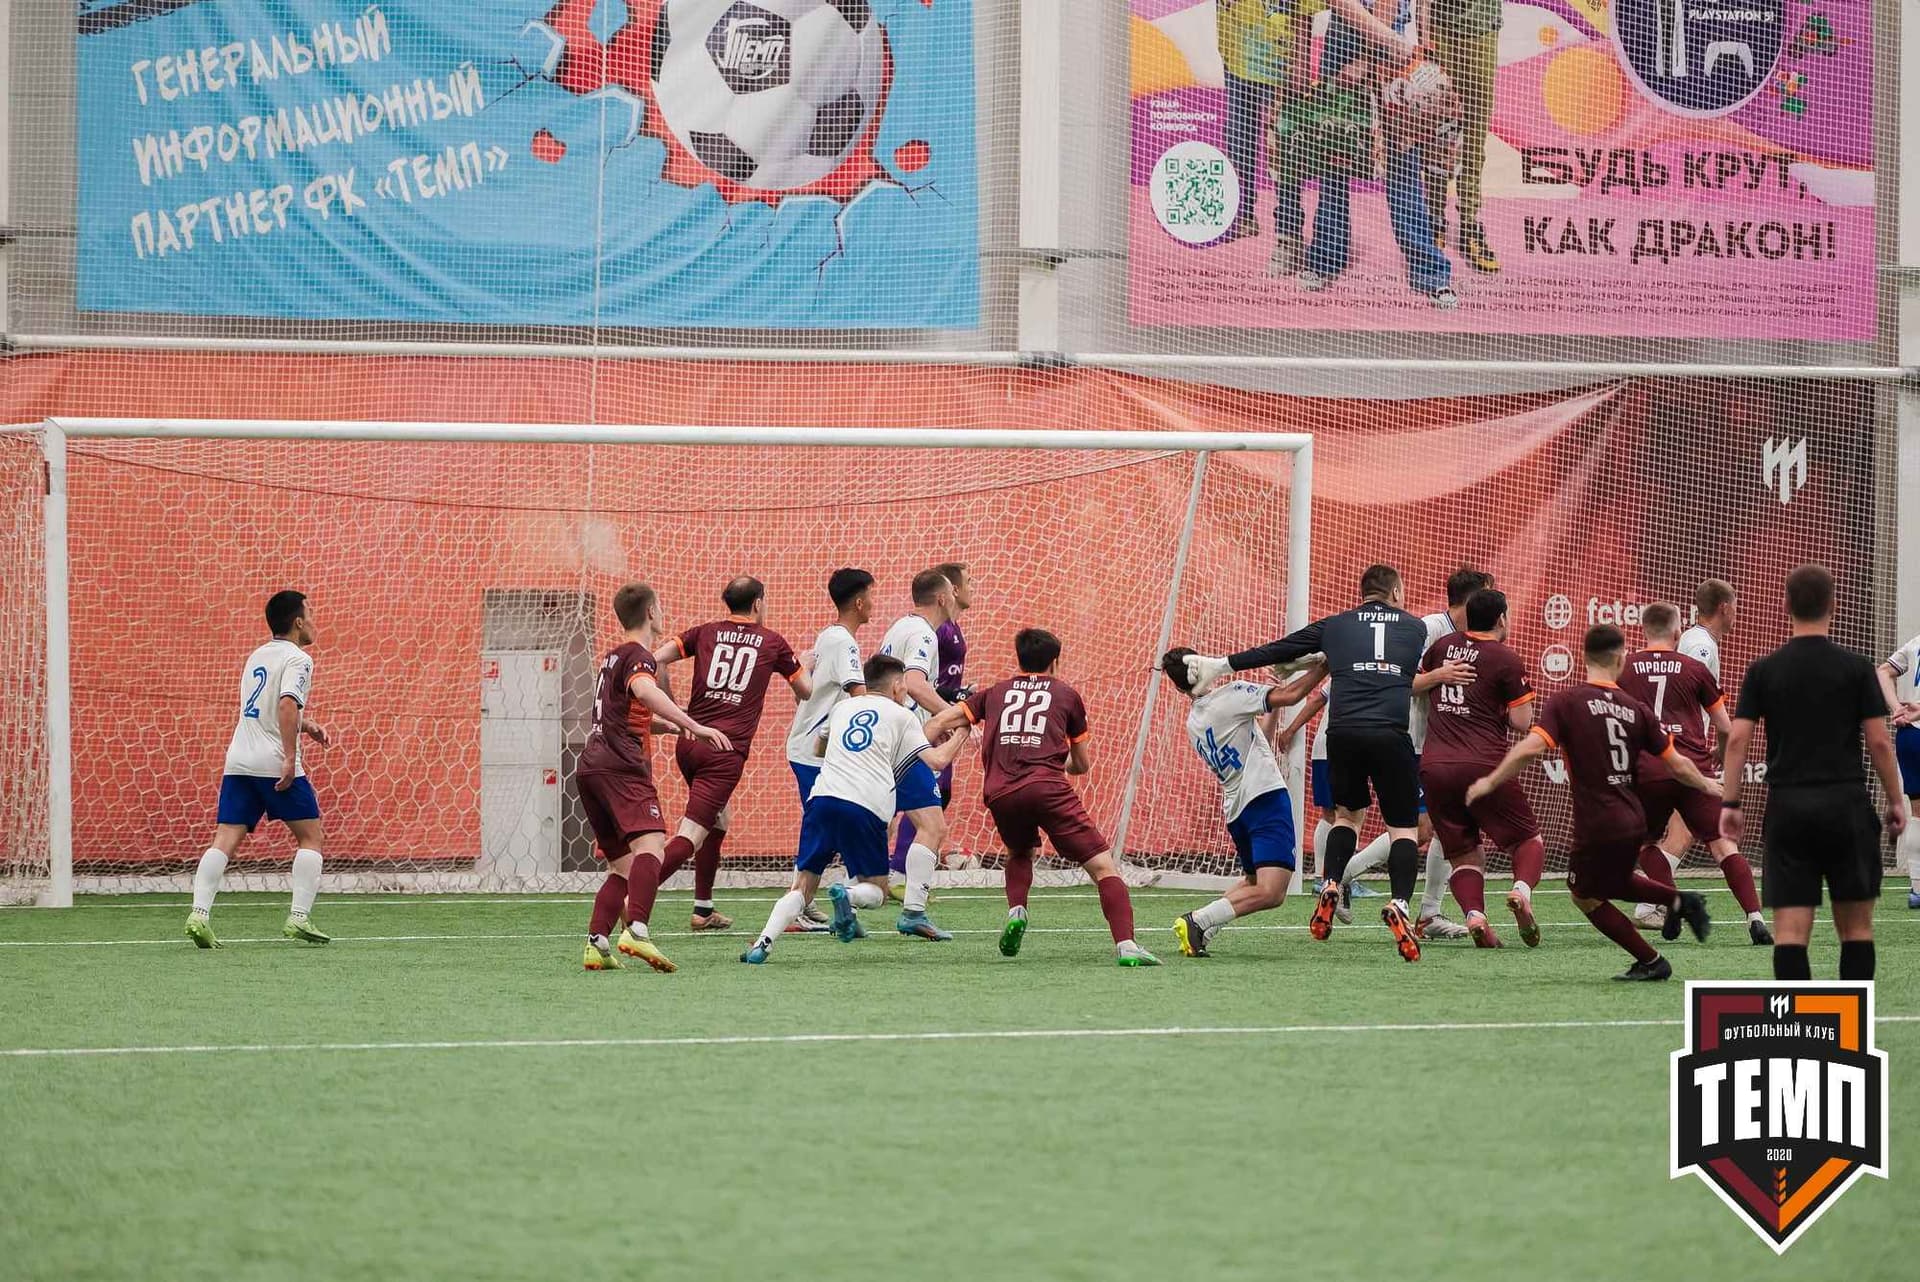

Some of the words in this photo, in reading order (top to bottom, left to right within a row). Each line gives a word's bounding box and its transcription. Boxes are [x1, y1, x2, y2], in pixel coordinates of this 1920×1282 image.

[1688, 9, 1760, 21] PLAYSTATION
[131, 4, 392, 106] ГЕНЕРАЛЬНЫЙ
[132, 62, 486, 187] ИНФОРМАЦИОННЫЙ
[1521, 146, 1671, 196] БУДЬ
[1684, 151, 1808, 199] КРУТ,
[131, 184, 294, 260] ПАРТНЕР
[303, 166, 366, 220] ФК
[375, 142, 510, 204] «ТЕМП»
[1523, 215, 1620, 257] КАК
[1630, 219, 1837, 265] ДРАКОН!
[1357, 612, 1400, 623] ТРУБИН
[1369, 622, 1386, 661] 1
[706, 643, 758, 692] 60
[1352, 662, 1402, 676] SEUS
[1632, 660, 1683, 675] ТАРАСОВ
[243, 665, 269, 720] 2
[999, 689, 1053, 735] 22
[1647, 674, 1668, 722] 7
[842, 709, 880, 753] 8
[999, 735, 1042, 746] SEUS
[1605, 717, 1630, 772] 5
